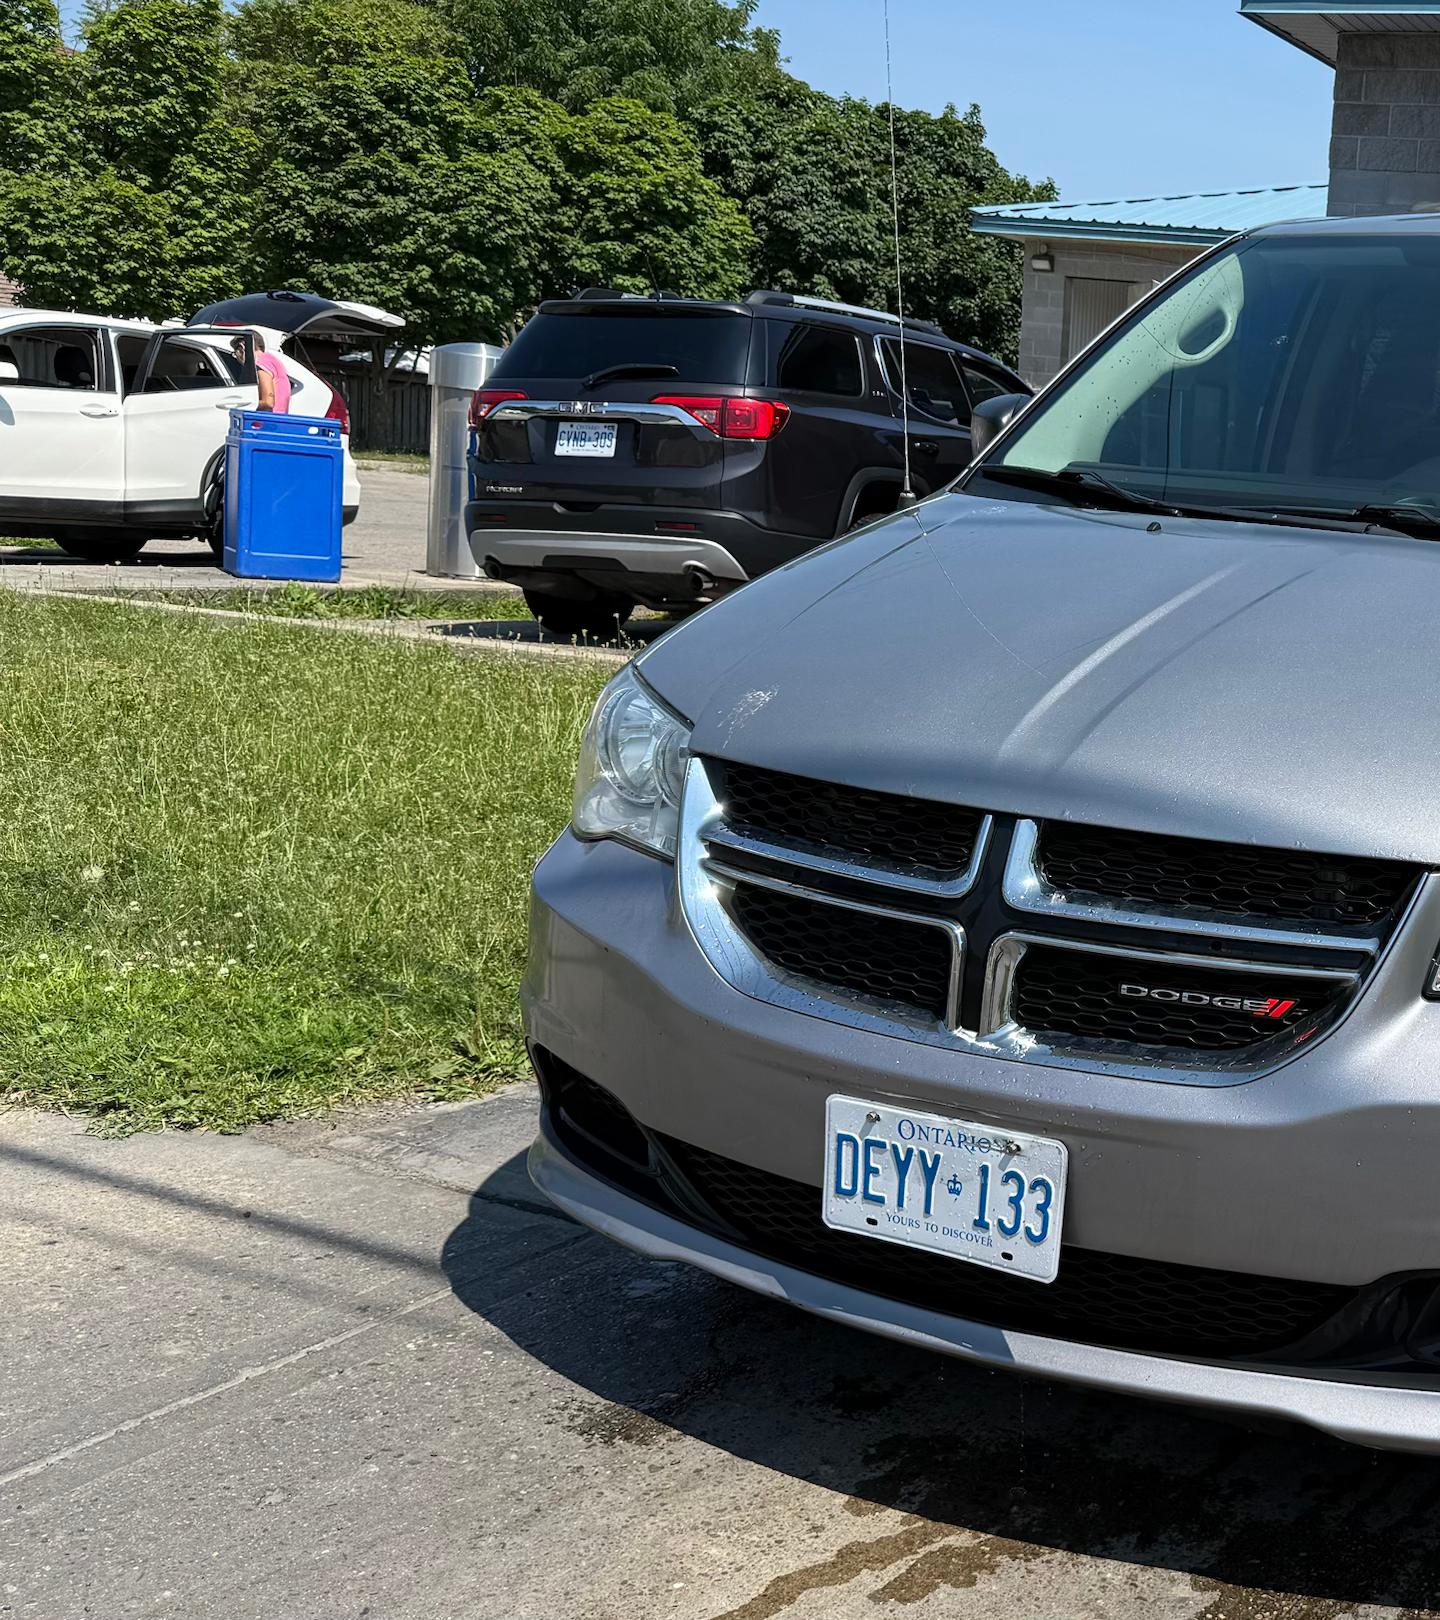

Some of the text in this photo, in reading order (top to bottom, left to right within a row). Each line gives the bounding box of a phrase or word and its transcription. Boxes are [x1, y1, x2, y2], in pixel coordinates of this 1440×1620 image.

[558, 430, 614, 449] CYNB 309
[1120, 983, 1272, 1012] DODGE
[834, 1132, 1054, 1245] DEYY 133
[886, 1212, 993, 1248] YOURS TO DISCOVER
